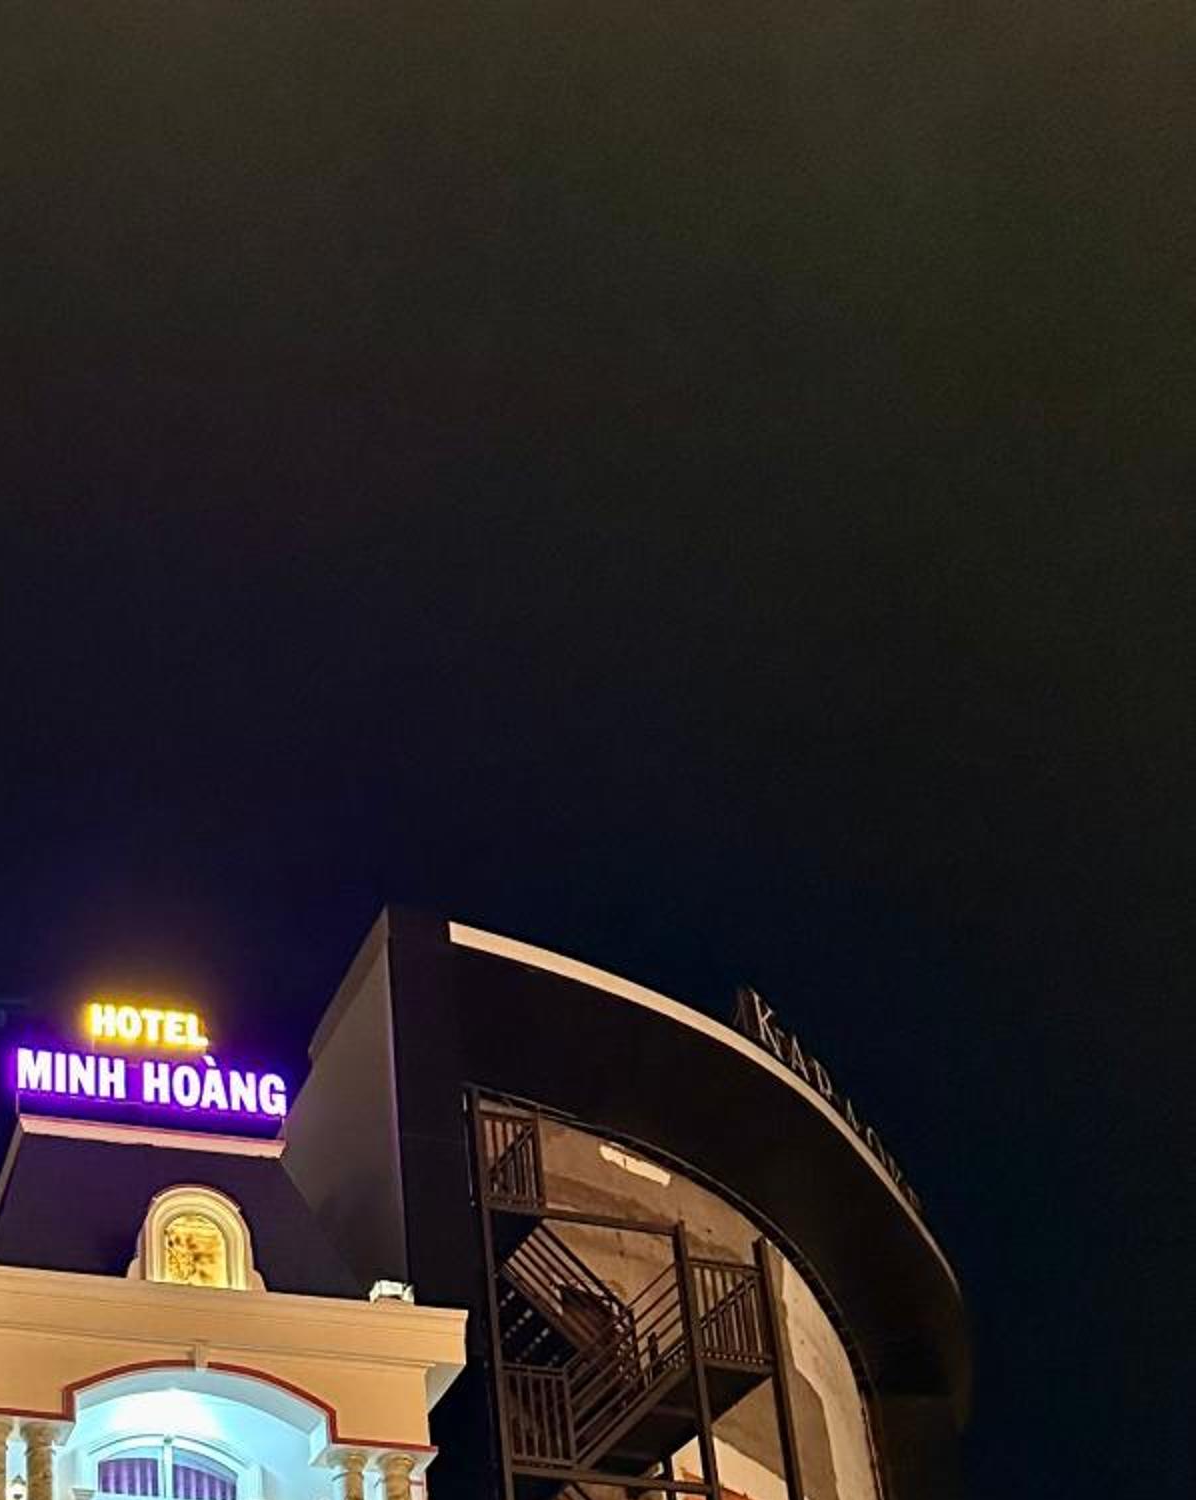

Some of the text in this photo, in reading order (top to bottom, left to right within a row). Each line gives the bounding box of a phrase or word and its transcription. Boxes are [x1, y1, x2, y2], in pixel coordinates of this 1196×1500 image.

[89, 1002, 209, 1047] HOTEL
[16, 1048, 287, 1116] MINH HOÀNG
